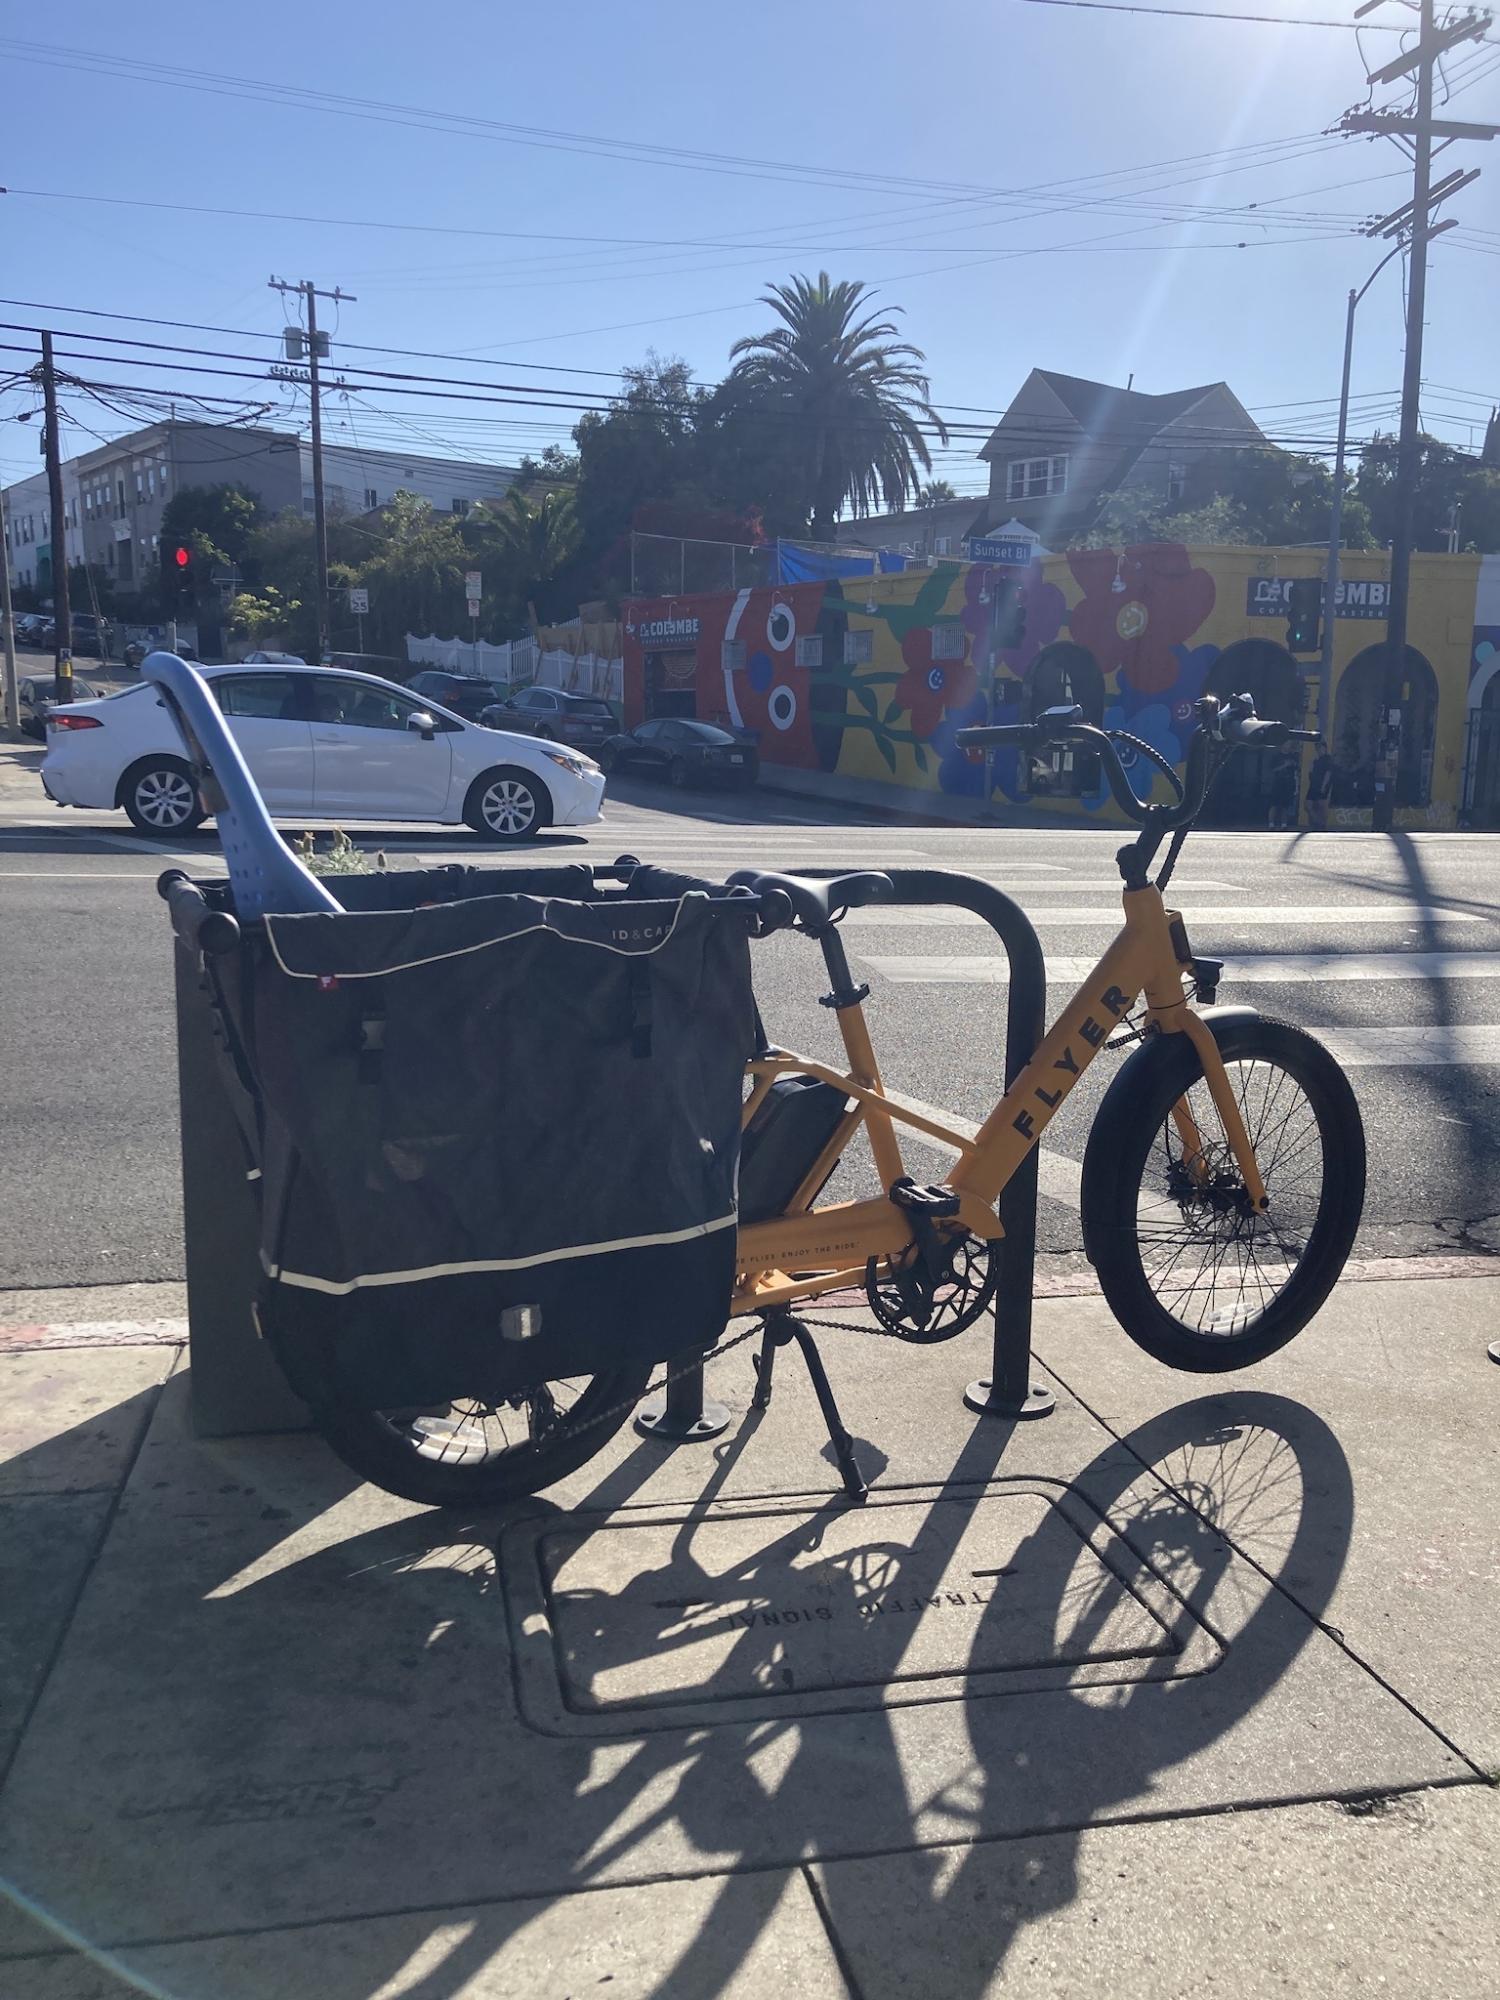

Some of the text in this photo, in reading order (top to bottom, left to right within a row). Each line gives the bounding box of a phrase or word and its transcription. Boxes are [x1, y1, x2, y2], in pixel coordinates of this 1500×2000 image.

[975, 543, 1013, 559] Sunset
[353, 601, 368, 611] 25
[1012, 985, 1131, 1140] FLYER
[781, 1247, 810, 1258] ENJOY
[815, 1245, 831, 1254] THE
[857, 1591, 990, 1615] TRAFFIC
